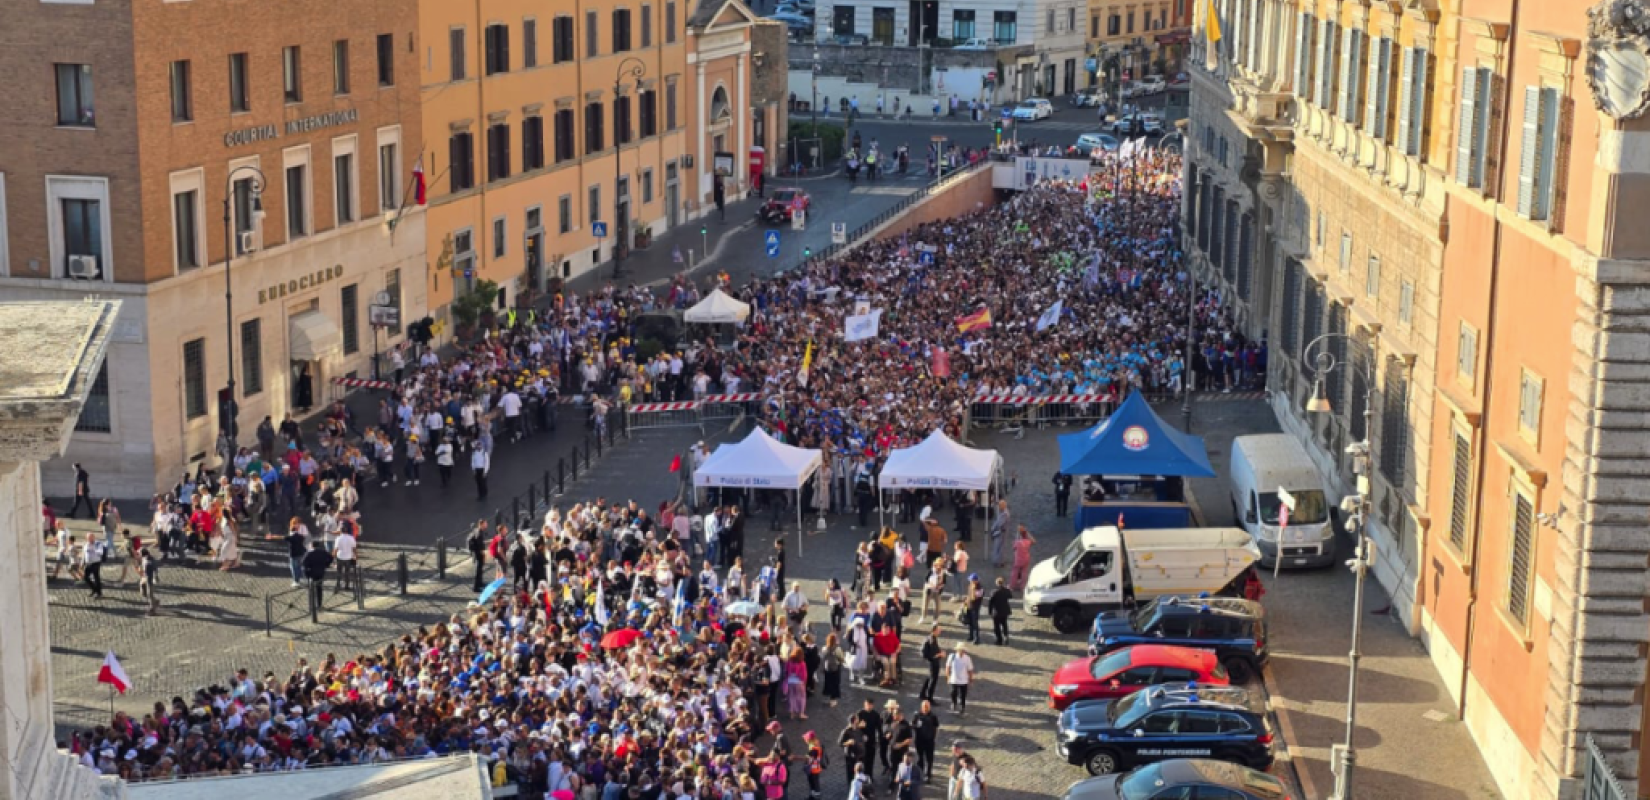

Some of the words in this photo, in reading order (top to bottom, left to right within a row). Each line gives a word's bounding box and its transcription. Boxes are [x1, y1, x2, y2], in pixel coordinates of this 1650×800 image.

[224, 124, 278, 148] COURTIAL
[285, 108, 358, 135] INTERNATIONAL
[258, 264, 343, 304] EUROCLERO
